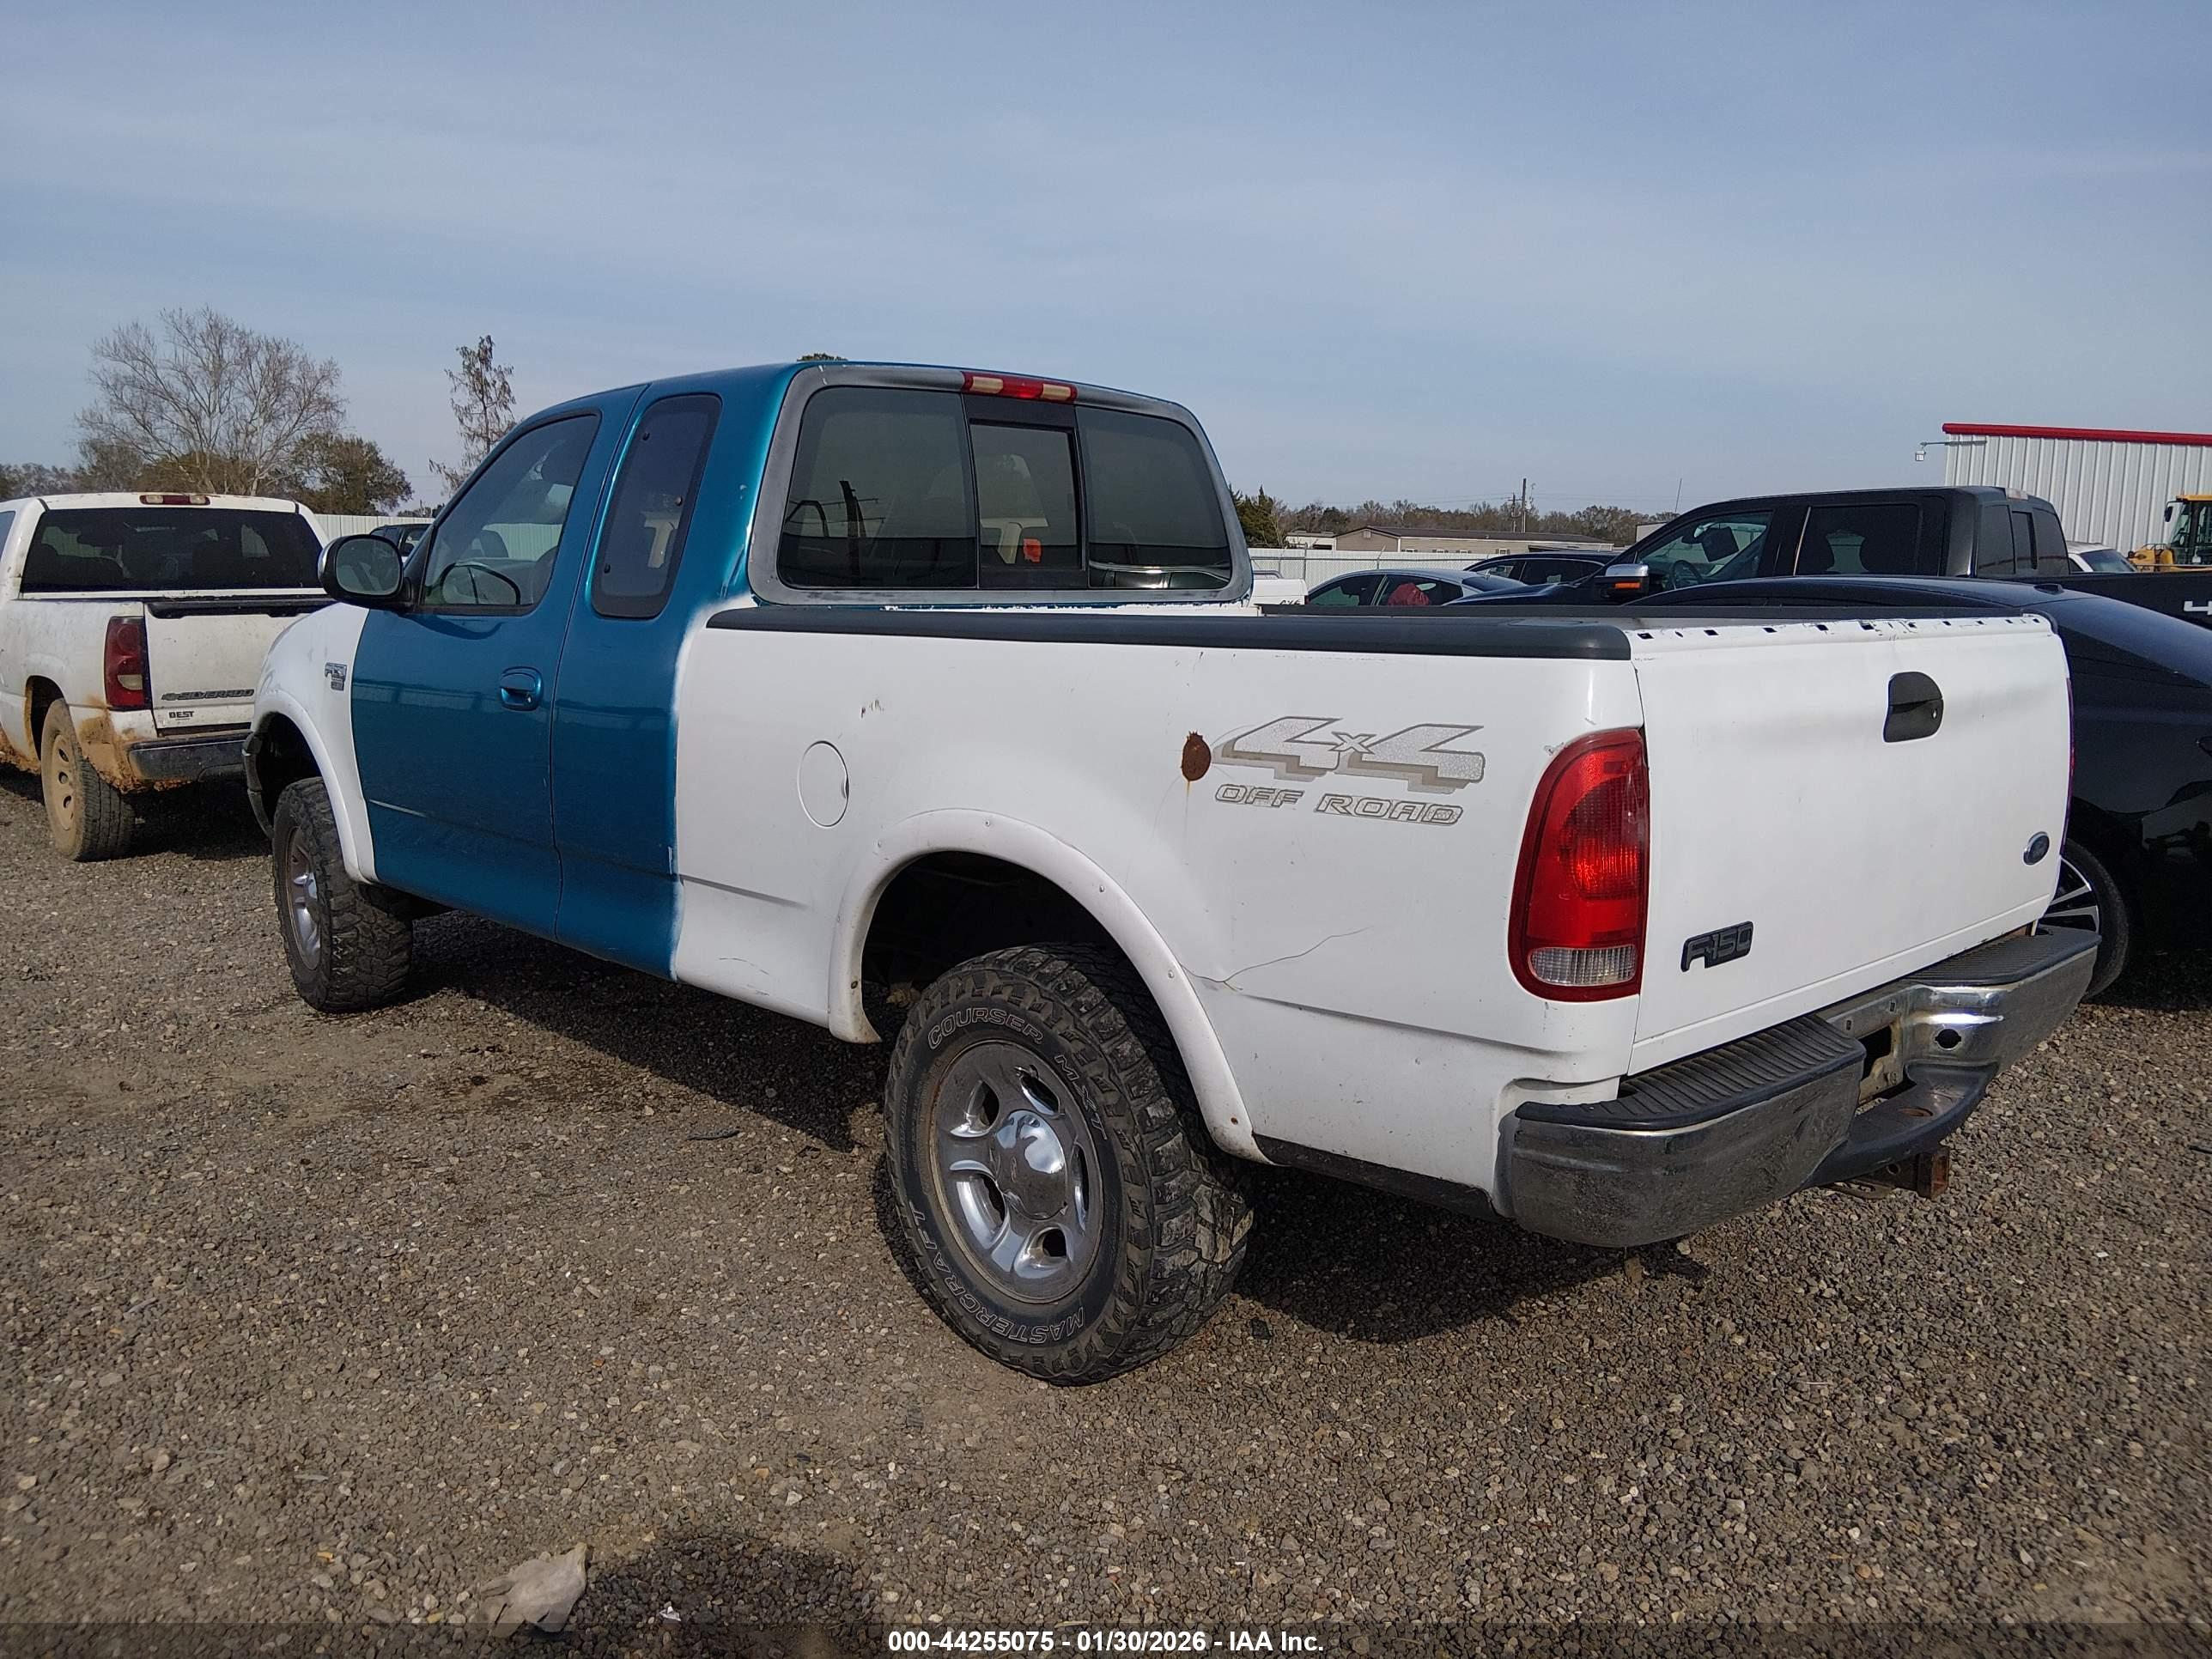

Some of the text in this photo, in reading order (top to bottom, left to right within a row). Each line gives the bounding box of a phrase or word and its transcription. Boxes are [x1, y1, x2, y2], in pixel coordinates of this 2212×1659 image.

[177, 689, 254, 701] SILVERADO
[1215, 784, 1463, 826] OFF ROAD
[927, 1007, 1108, 1140] COURSER MXT
[908, 1200, 1085, 1345] MASTERCRAFT
